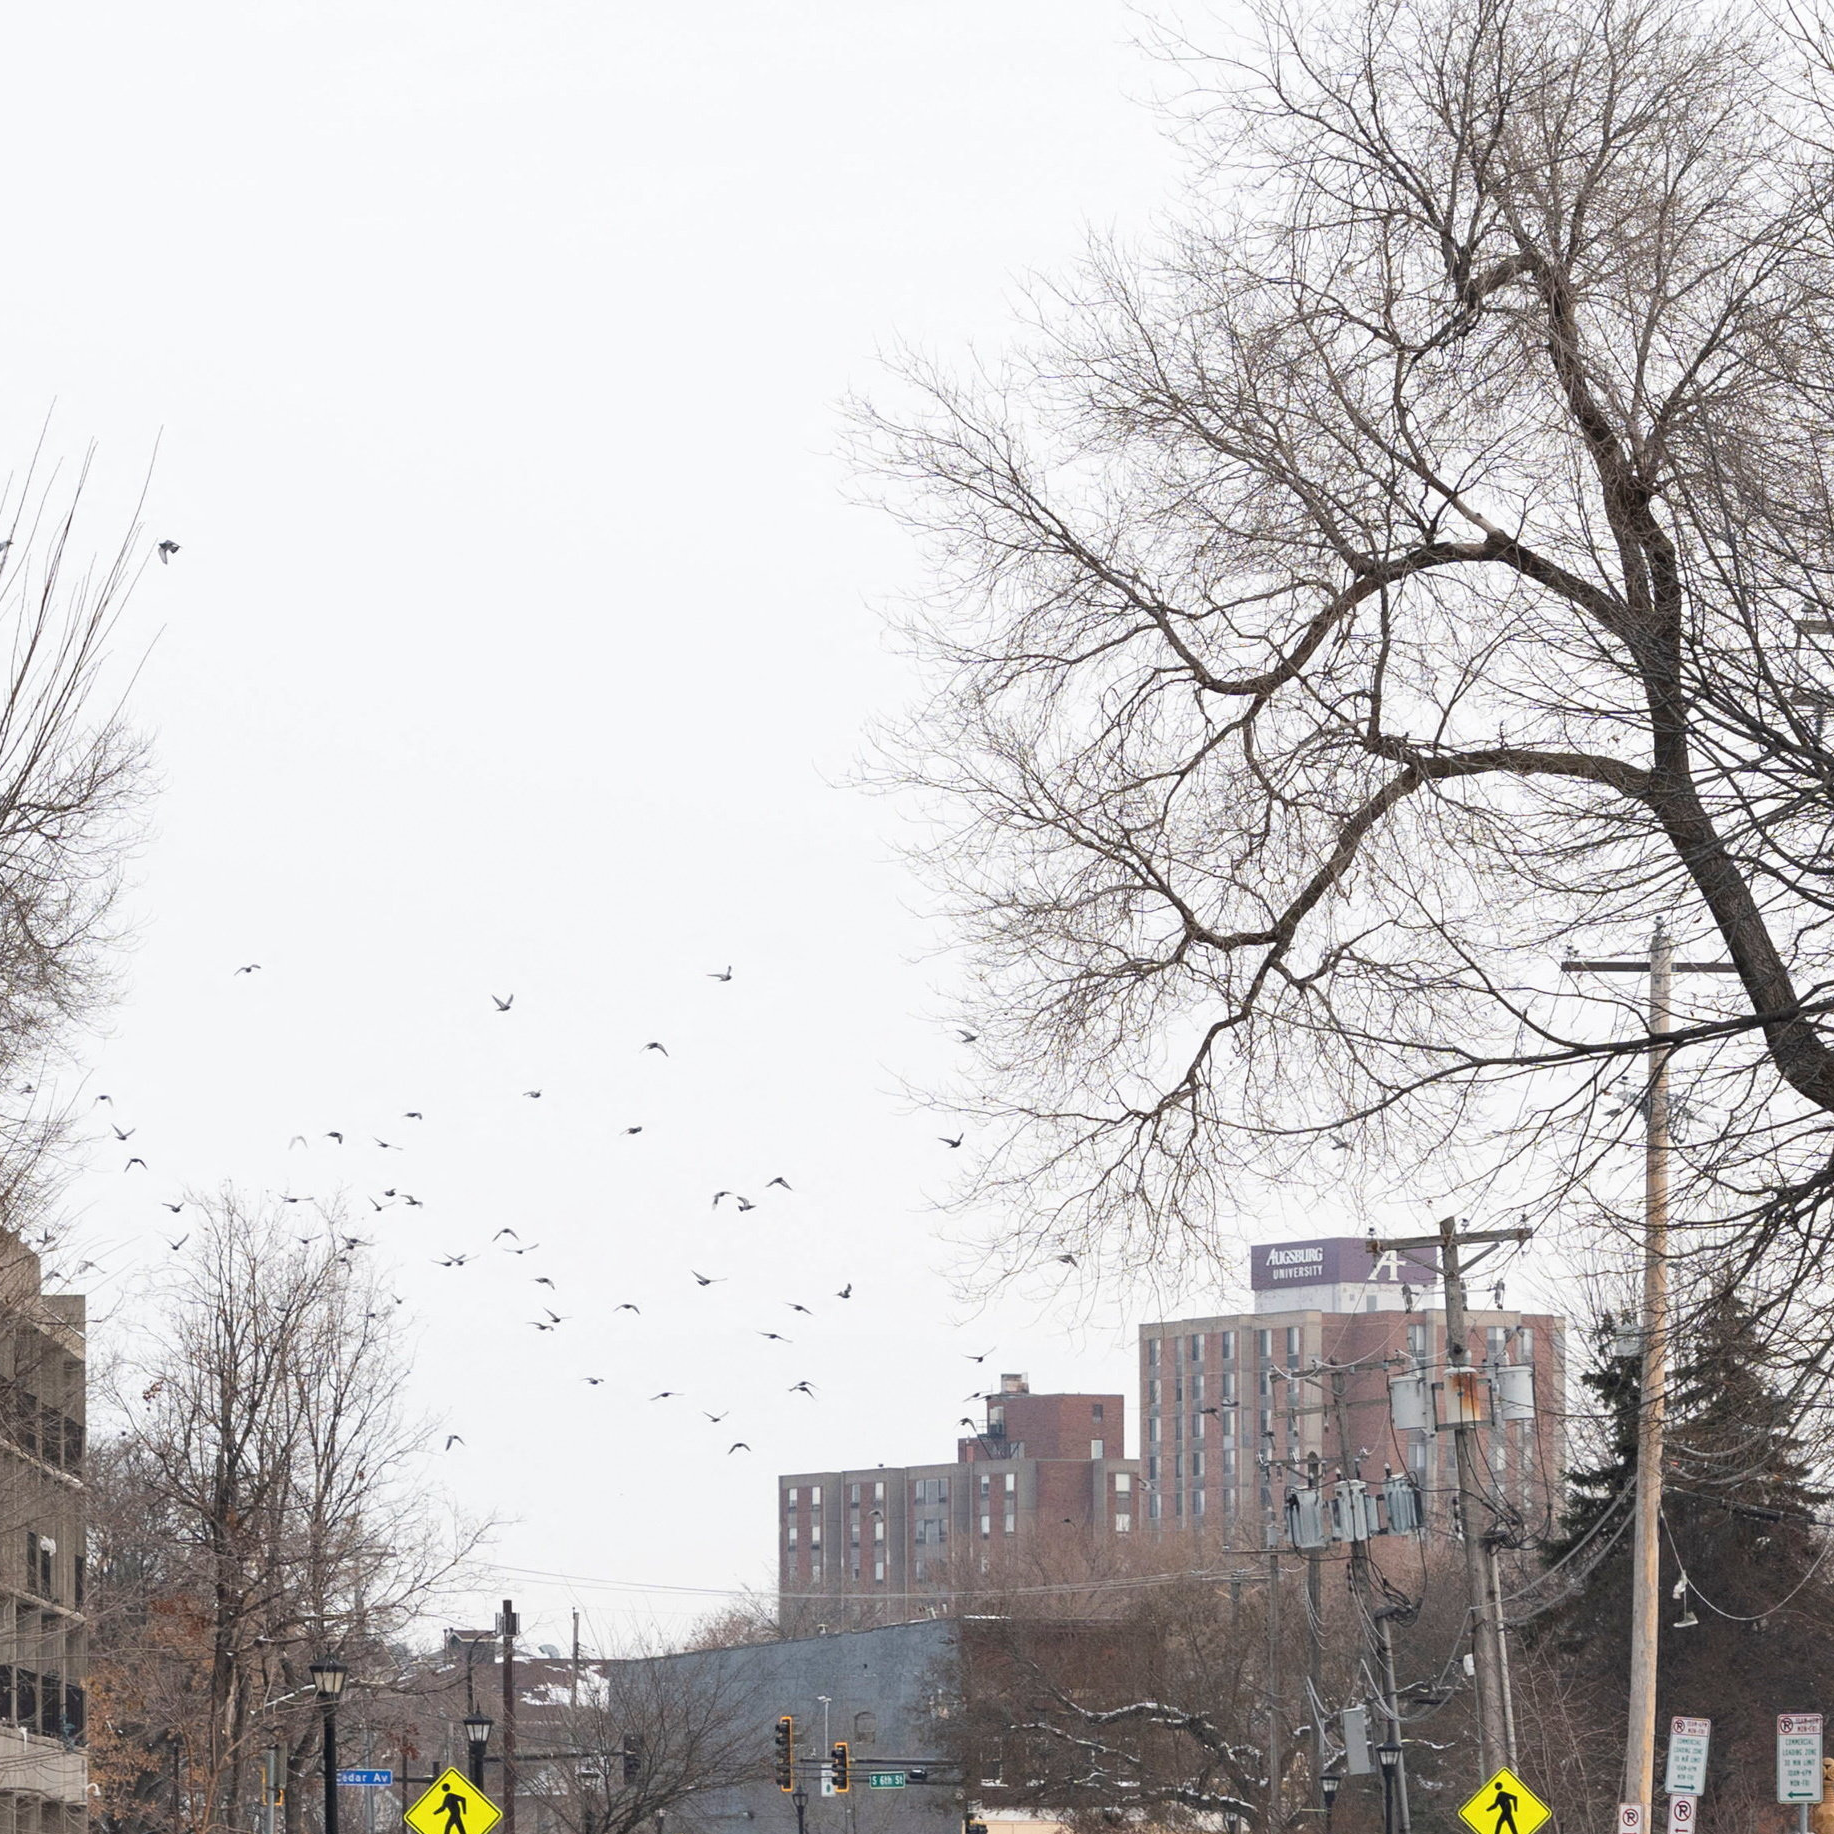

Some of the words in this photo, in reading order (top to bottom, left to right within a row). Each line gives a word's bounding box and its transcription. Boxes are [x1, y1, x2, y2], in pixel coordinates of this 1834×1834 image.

[1266, 1247, 1324, 1266] AUGSBURG
[1273, 1264, 1323, 1280] UNIVERSITY
[373, 1772, 388, 1782] Av
[872, 1775, 877, 1786] S
[880, 1775, 893, 1785] 6th
[895, 1774, 903, 1785] St
